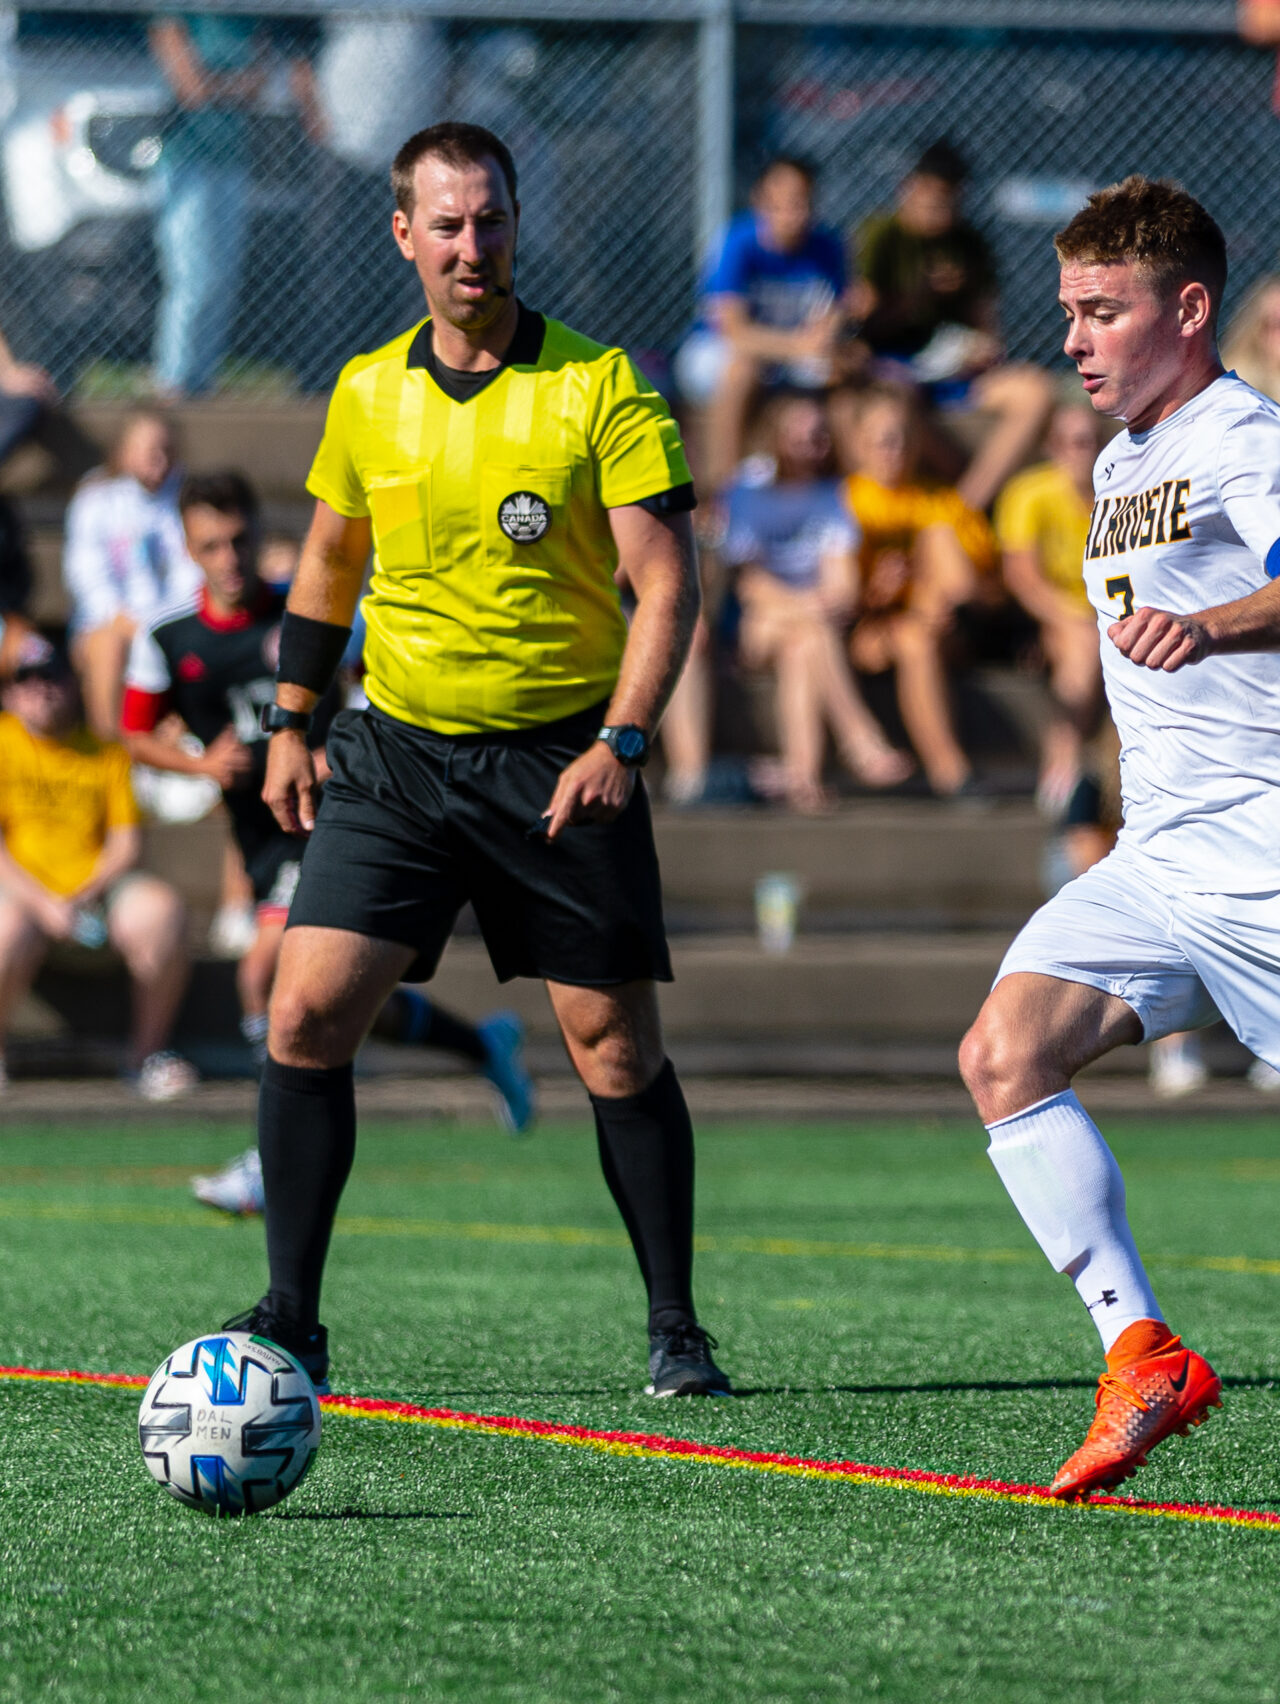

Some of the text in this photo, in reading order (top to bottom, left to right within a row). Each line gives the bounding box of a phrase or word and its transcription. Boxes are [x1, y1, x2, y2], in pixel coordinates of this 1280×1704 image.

[502, 514, 547, 523] CANADA
[196, 1409, 233, 1424] DAL
[196, 1425, 231, 1440] MEN
